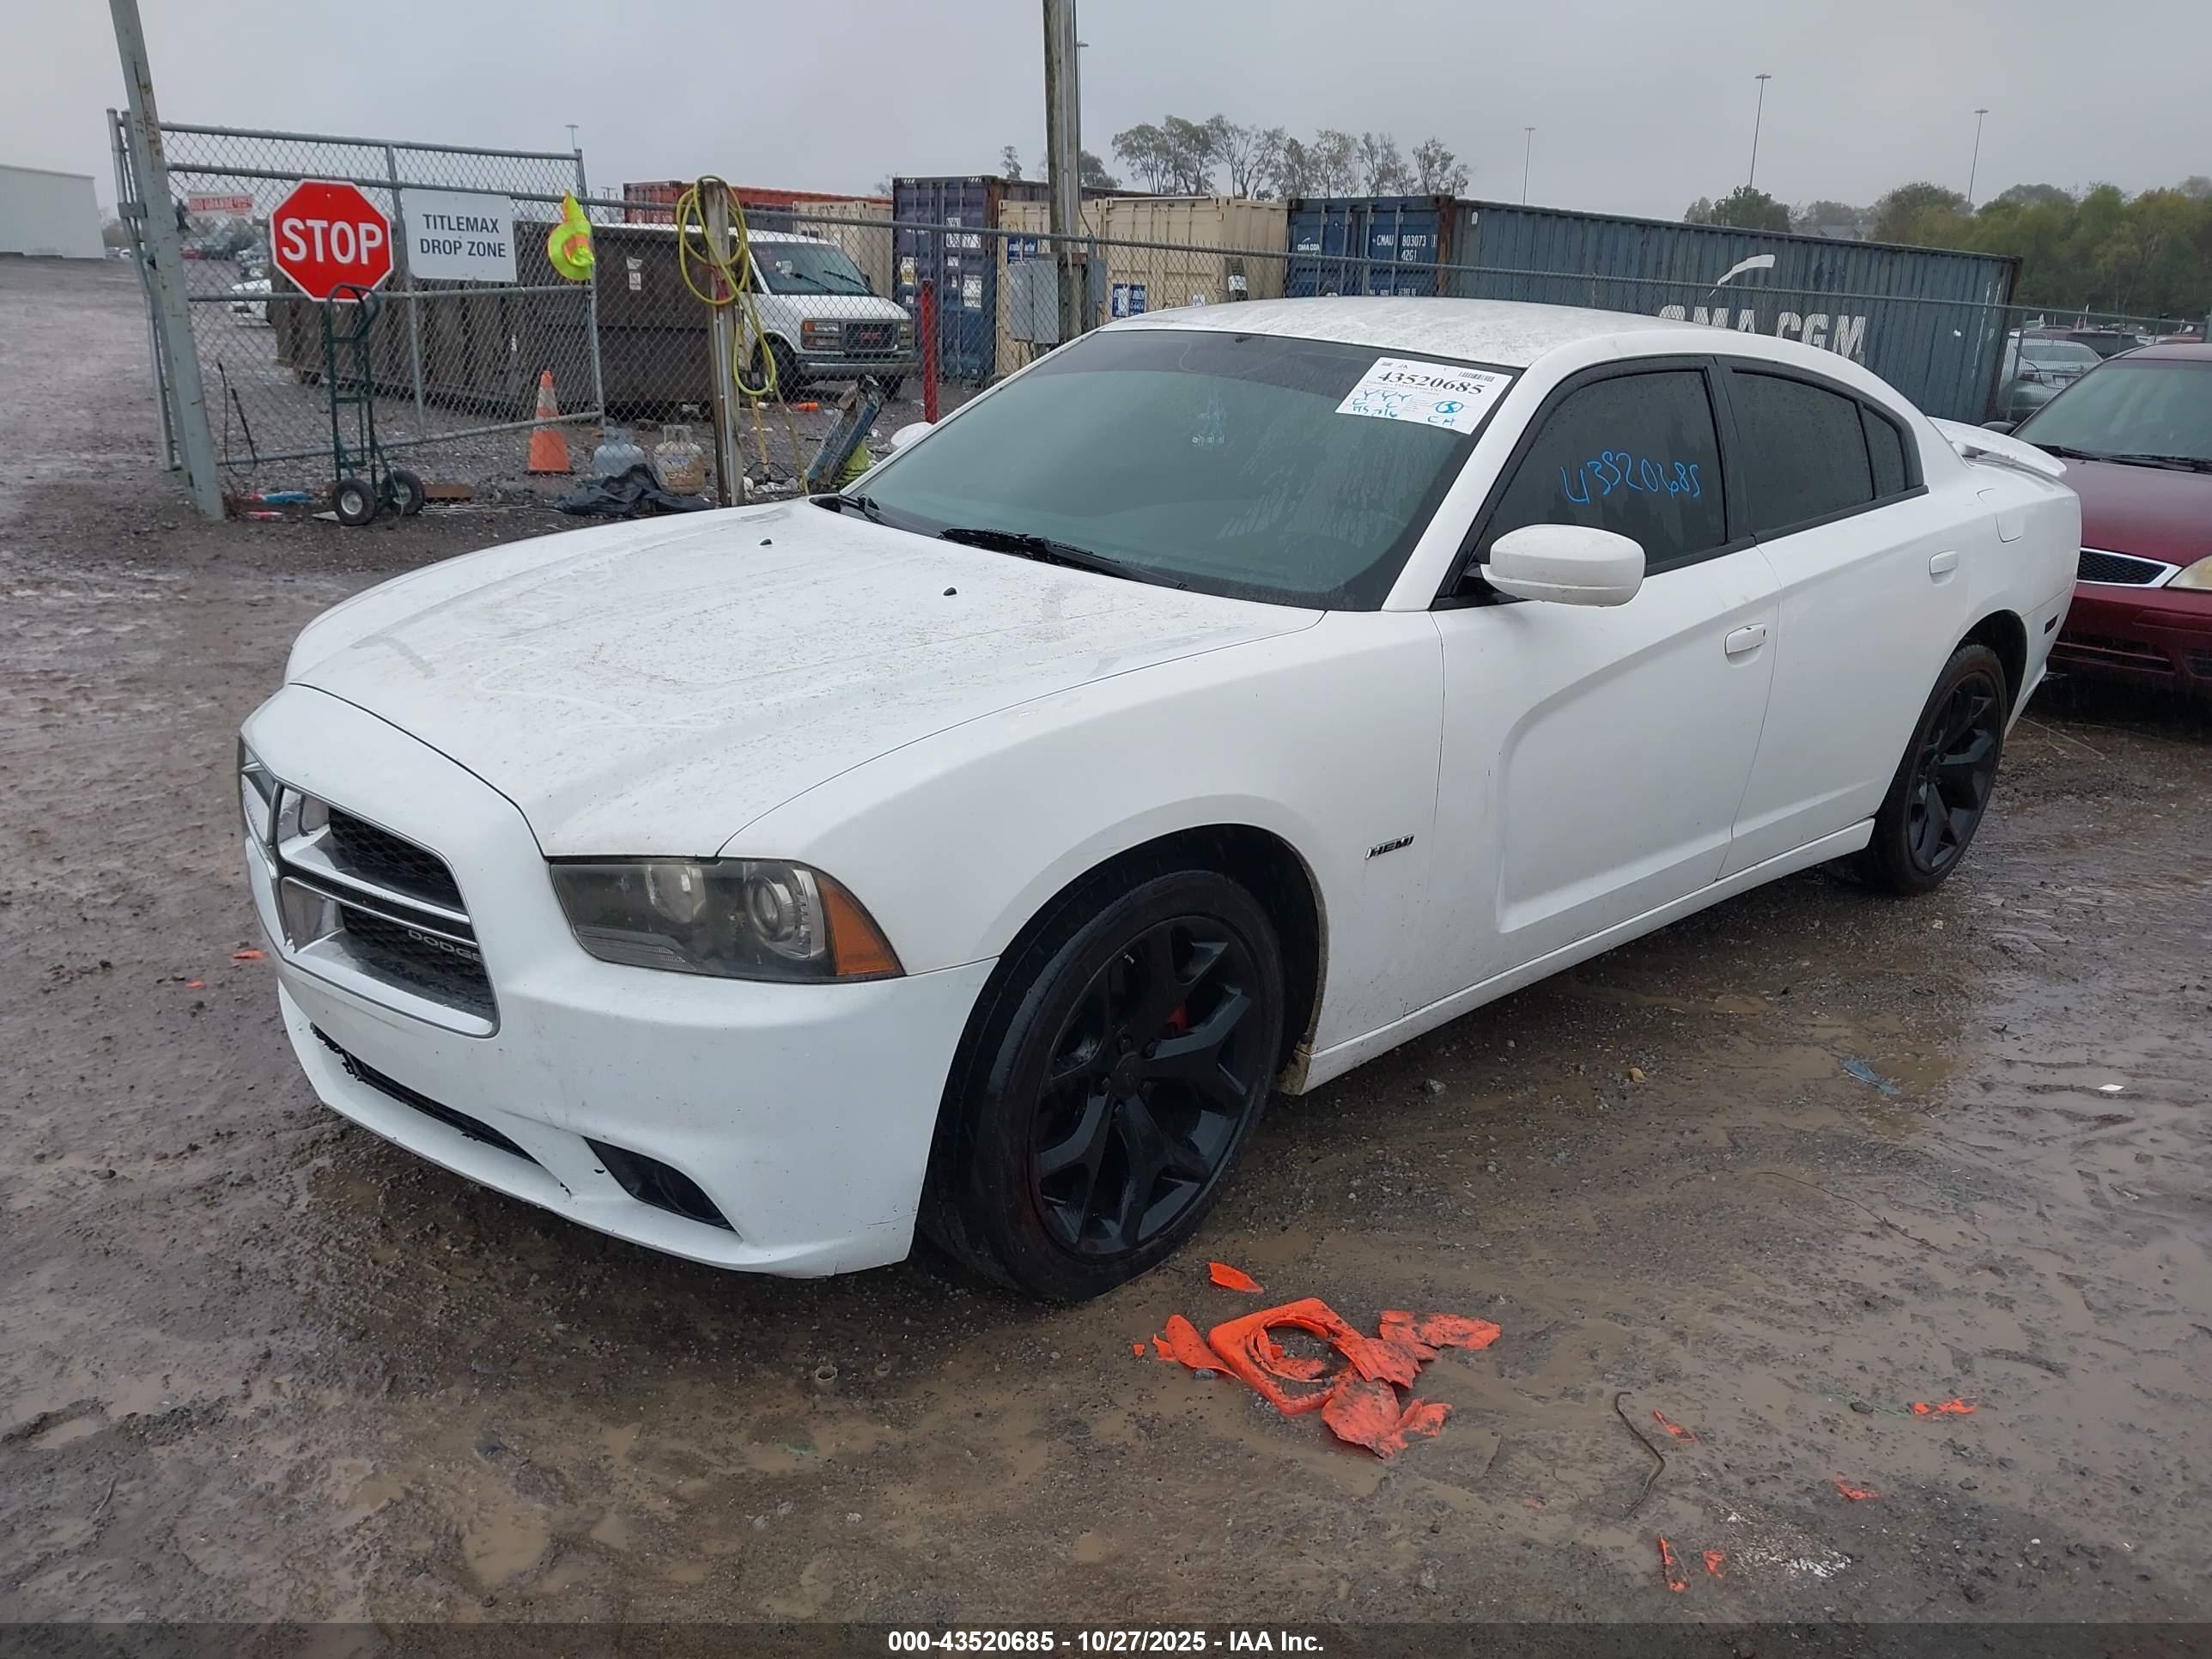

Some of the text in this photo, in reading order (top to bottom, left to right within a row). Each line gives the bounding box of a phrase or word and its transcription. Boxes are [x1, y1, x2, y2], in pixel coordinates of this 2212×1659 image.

[422, 214, 500, 234] TITLEMAX
[282, 217, 383, 264] STOP
[420, 238, 507, 258] DROP ZONE
[1376, 234, 1394, 246] CMAU
[1401, 234, 1426, 247] 803073
[1401, 249, 1417, 261] 42G1
[1377, 371, 1486, 395] 43520685
[1364, 833, 1415, 860] HEMI
[408, 929, 482, 962] DODGE
